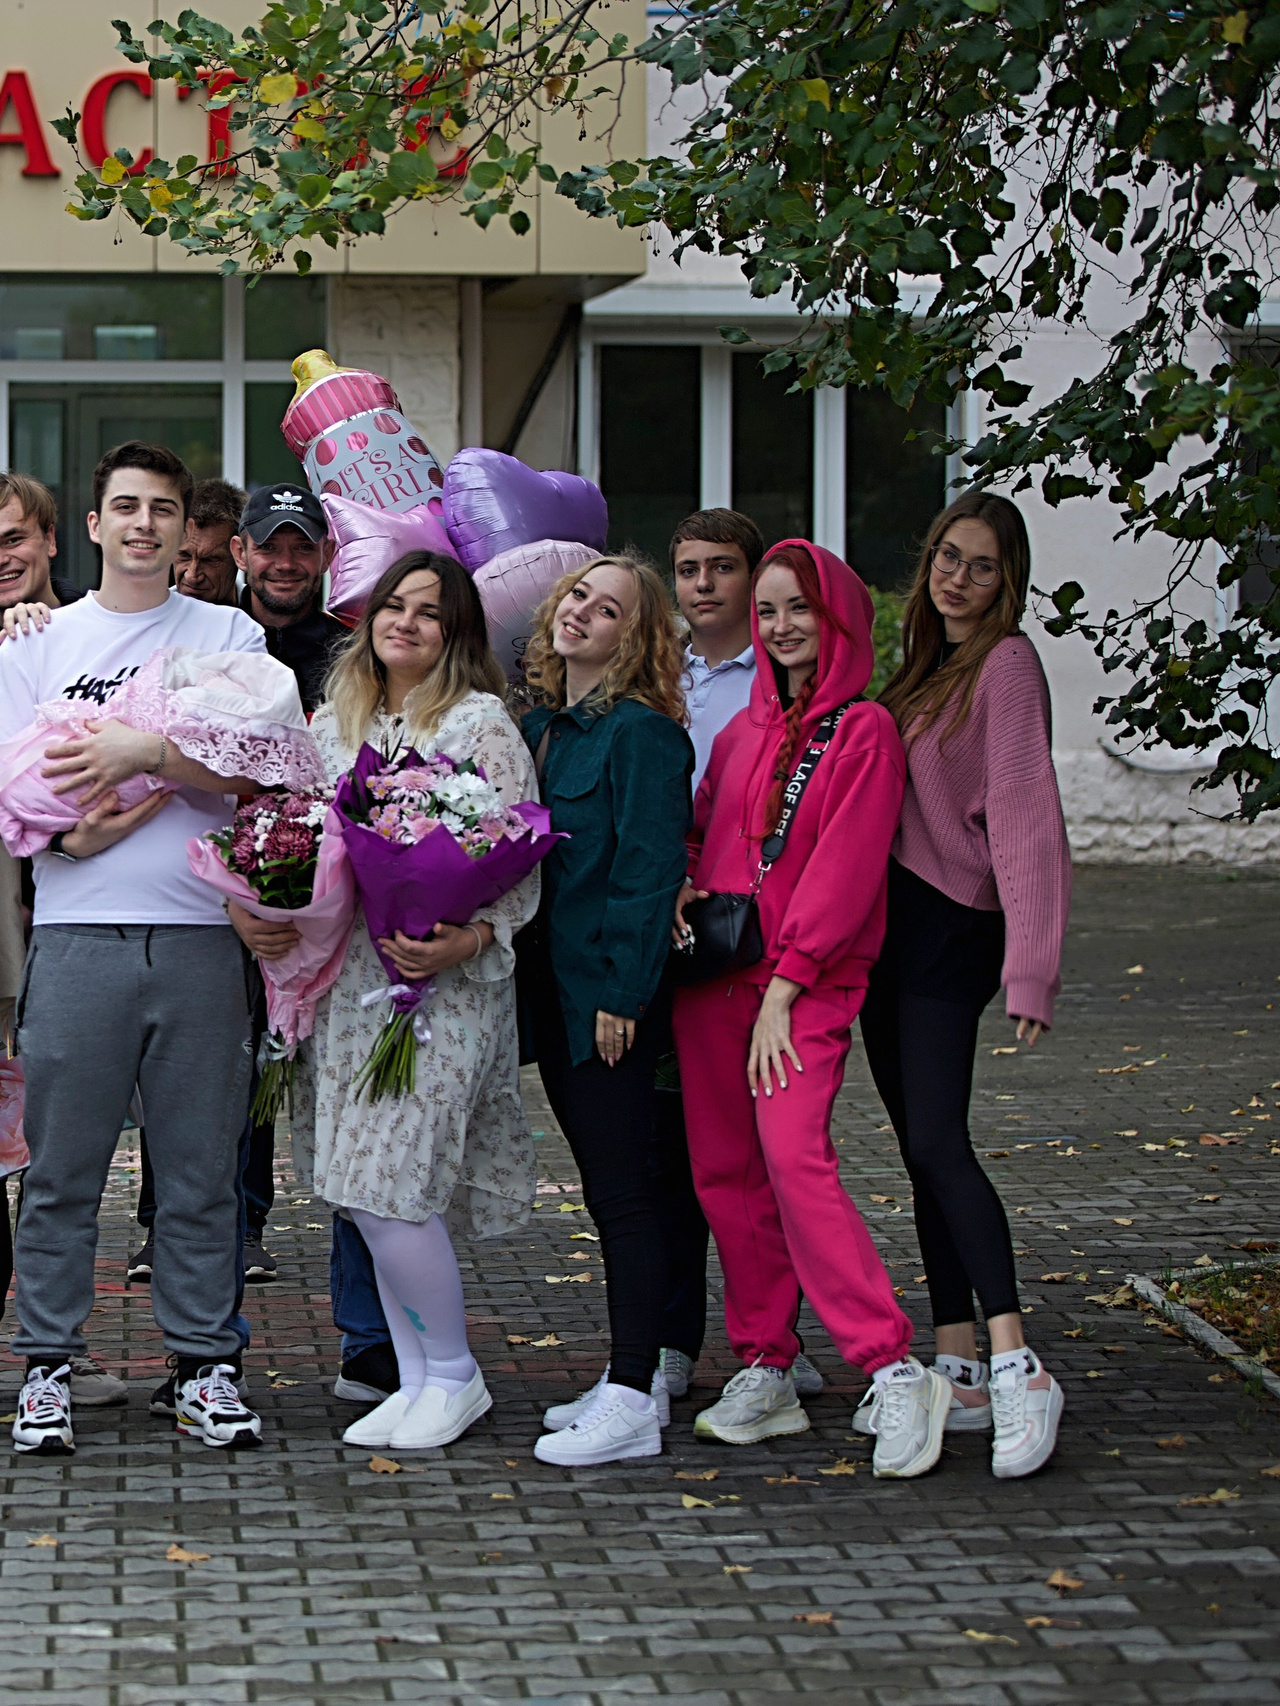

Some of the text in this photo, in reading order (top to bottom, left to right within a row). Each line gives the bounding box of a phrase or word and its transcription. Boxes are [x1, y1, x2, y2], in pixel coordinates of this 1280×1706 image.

[337, 443, 421, 495] IT'S A
[351, 466, 433, 510] GIRL
[270, 503, 304, 512] adidas
